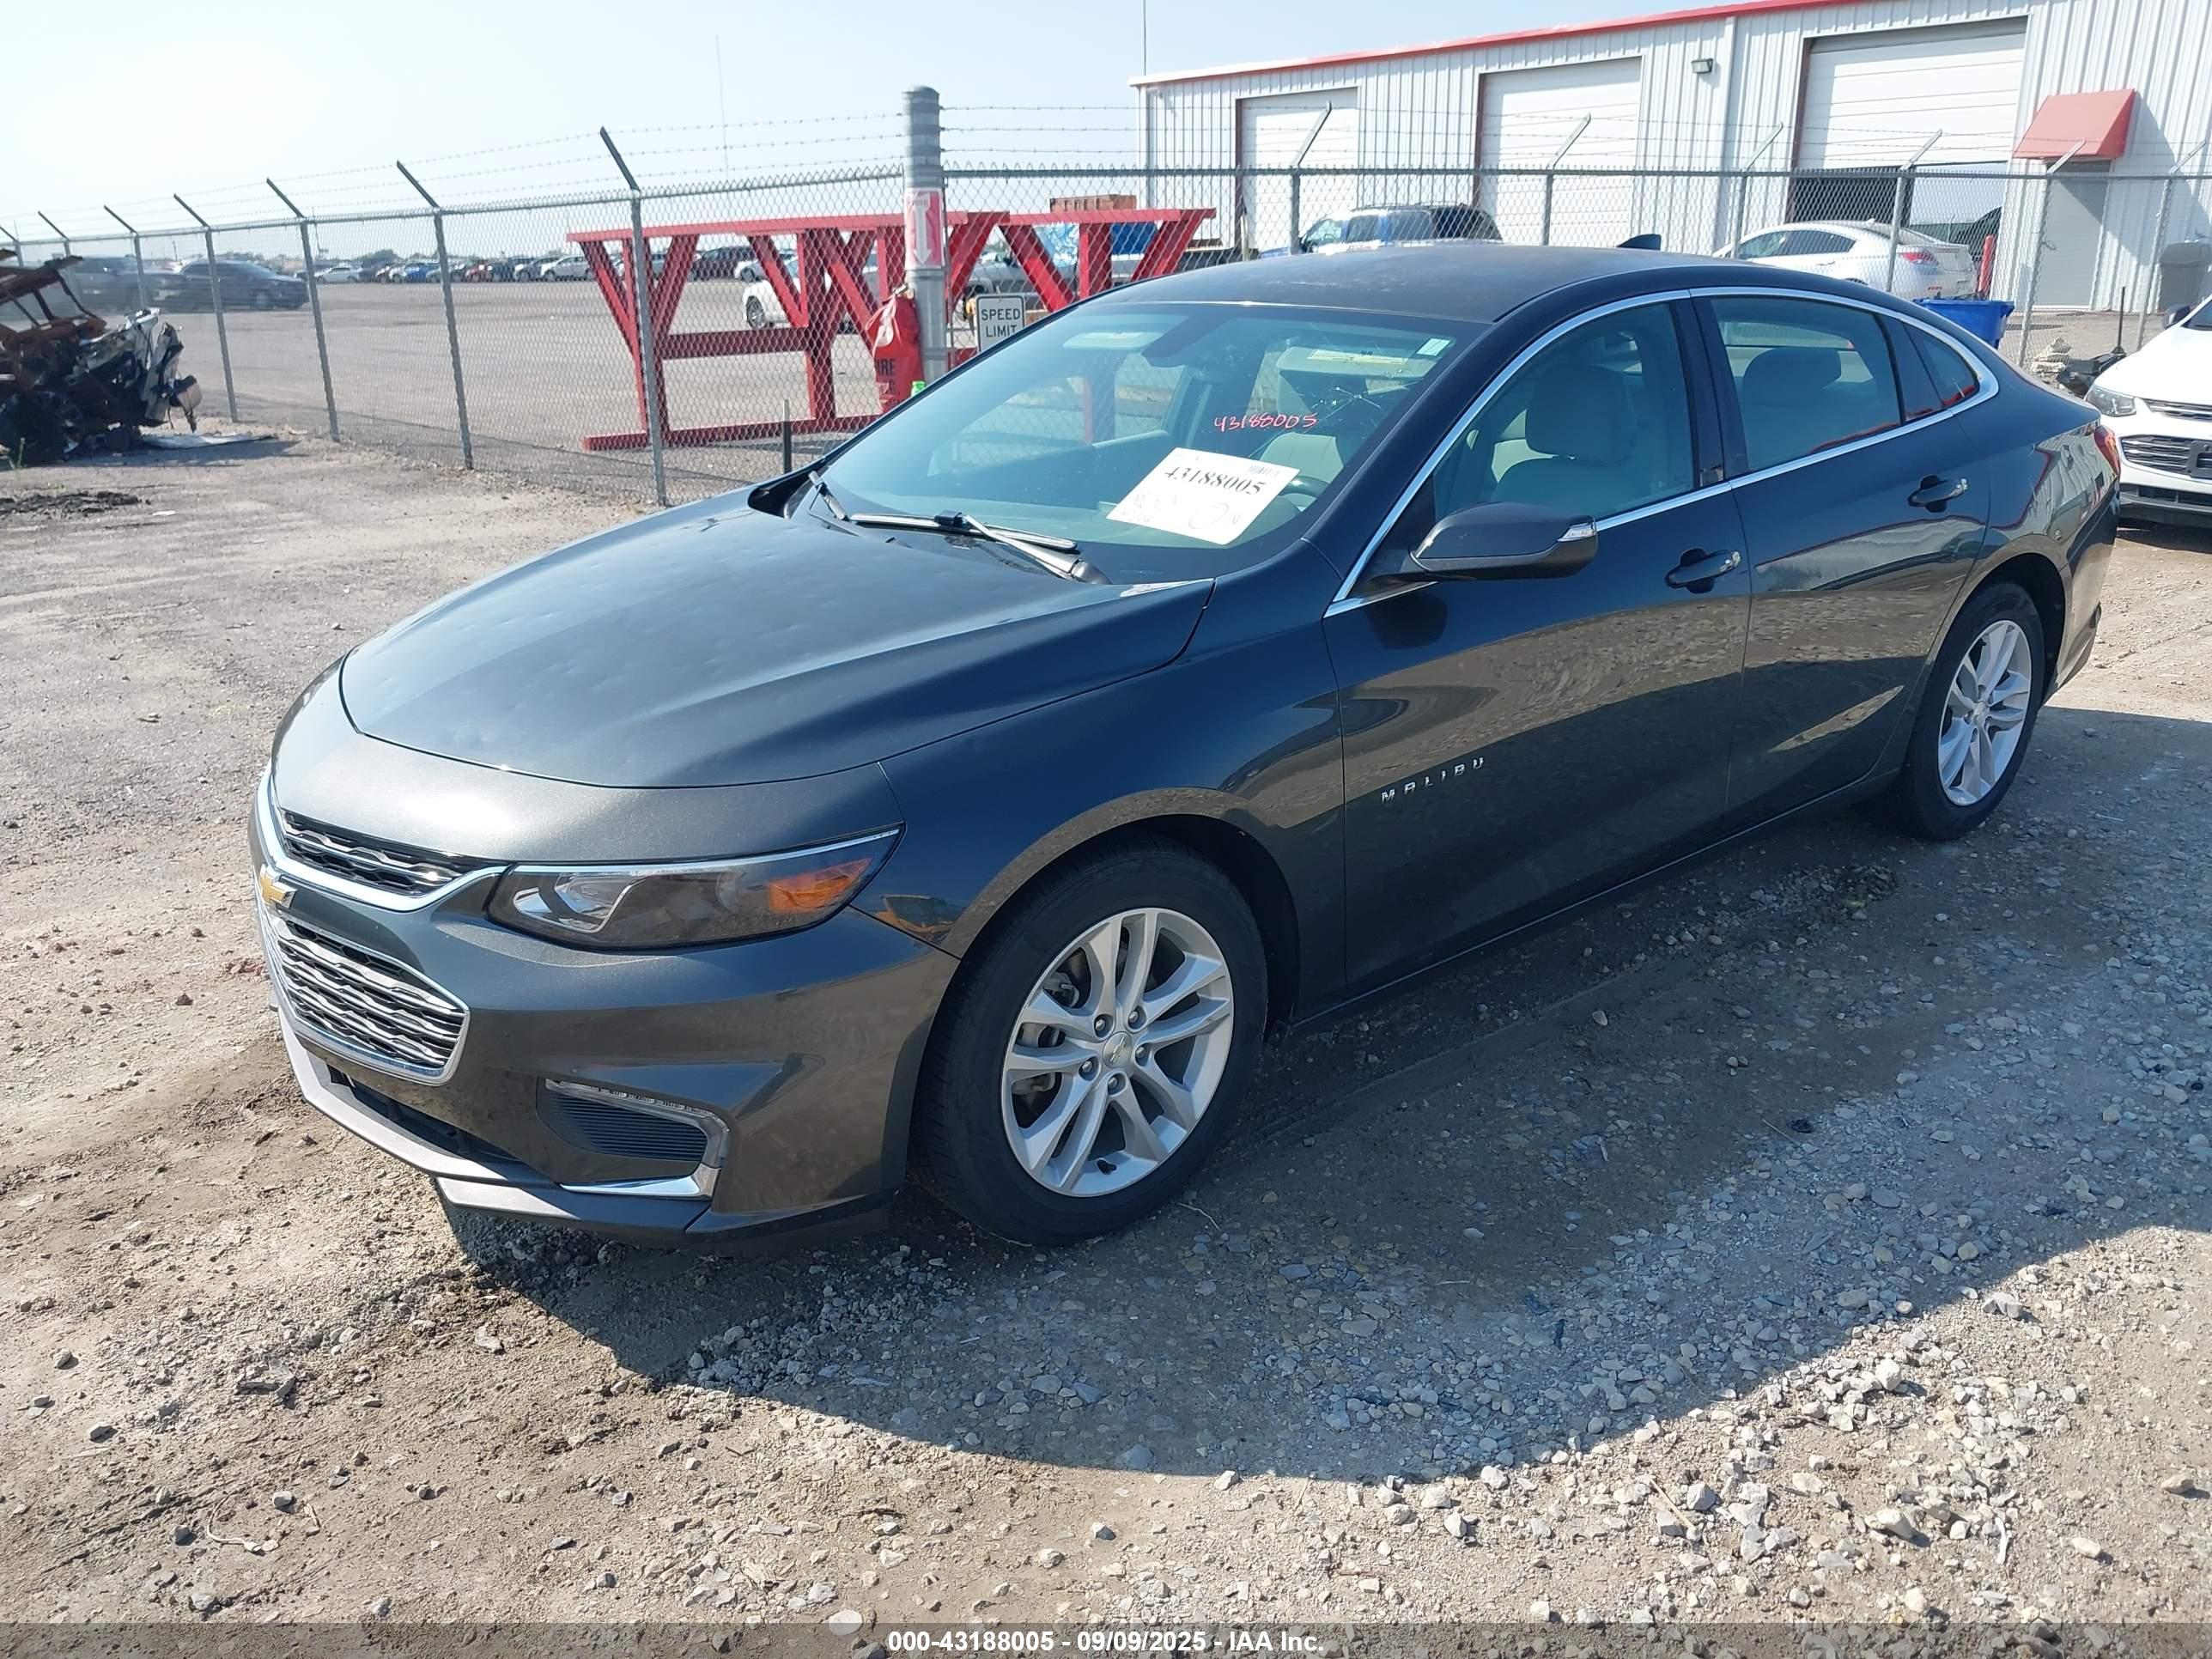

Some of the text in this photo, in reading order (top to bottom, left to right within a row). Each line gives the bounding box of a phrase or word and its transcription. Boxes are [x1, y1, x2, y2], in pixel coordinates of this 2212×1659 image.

[981, 308, 1021, 320] SPEED
[986, 325, 1017, 337] LIMIT
[1214, 412, 1319, 433] 43188005
[1164, 466, 1267, 495] 43188005
[1381, 757, 1485, 804] MALIBU
